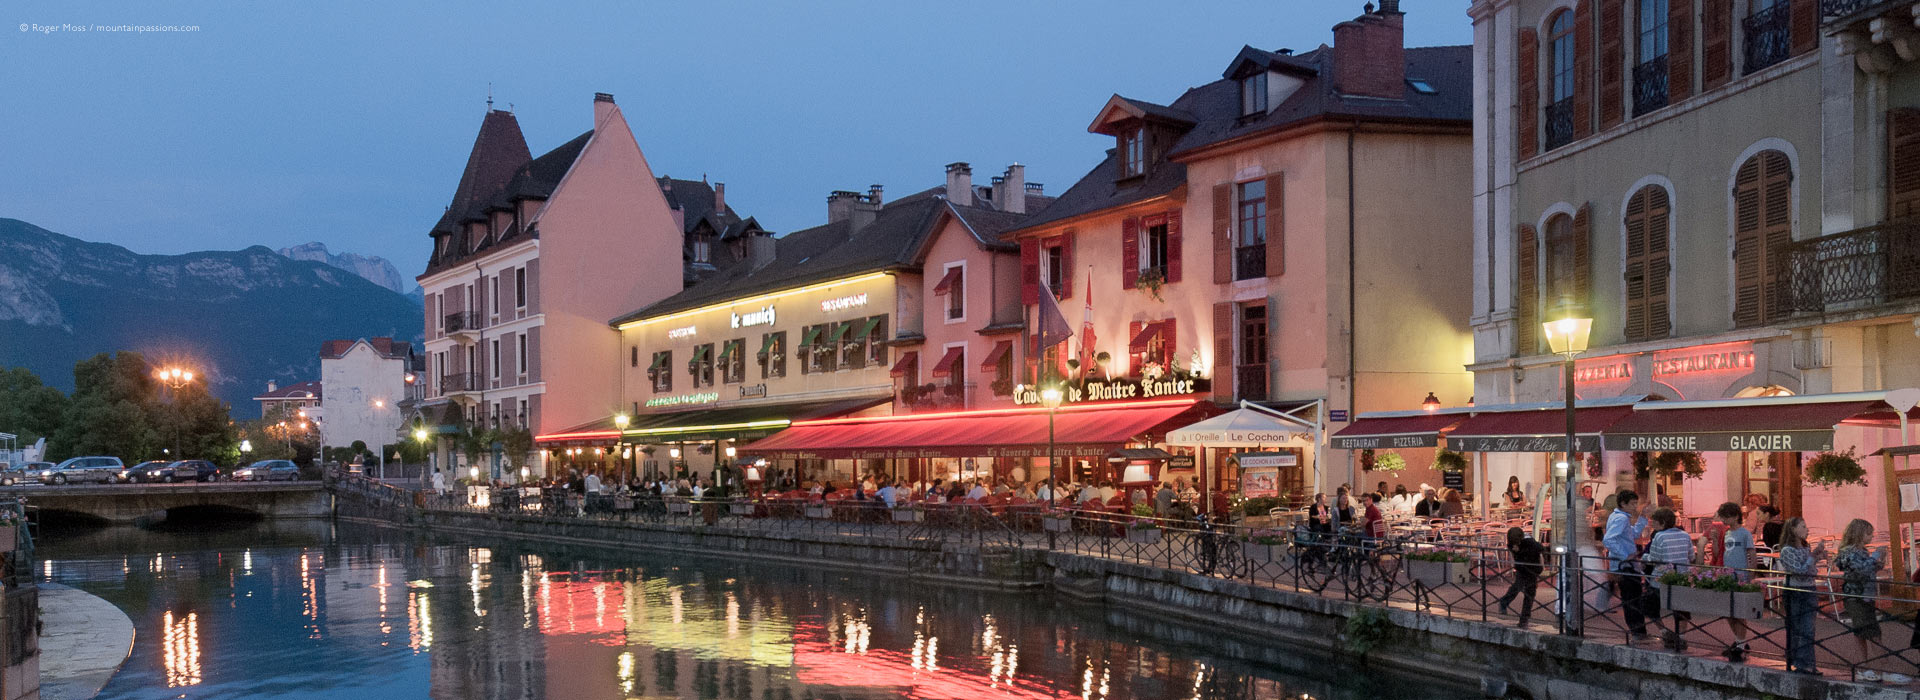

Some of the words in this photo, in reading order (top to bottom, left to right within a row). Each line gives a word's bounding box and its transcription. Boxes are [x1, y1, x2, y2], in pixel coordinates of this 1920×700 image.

[1652, 351, 1755, 377] RESTAURANT
[1568, 362, 1631, 382] IZZERIA
[1068, 385, 1082, 403] de
[1141, 378, 1195, 398] Kanter
[1181, 433, 1187, 441] à
[1189, 432, 1220, 441] l'Oreille
[1231, 432, 1243, 441] Le
[1247, 432, 1285, 441] Cochon
[1342, 438, 1380, 448] RESTAURANT
[1393, 436, 1424, 447] PIZZERIA
[1630, 436, 1697, 450] BRASSERIE
[1730, 434, 1793, 450] GLACIER
[1477, 438, 1491, 451] La
[1494, 438, 1519, 452] Table
